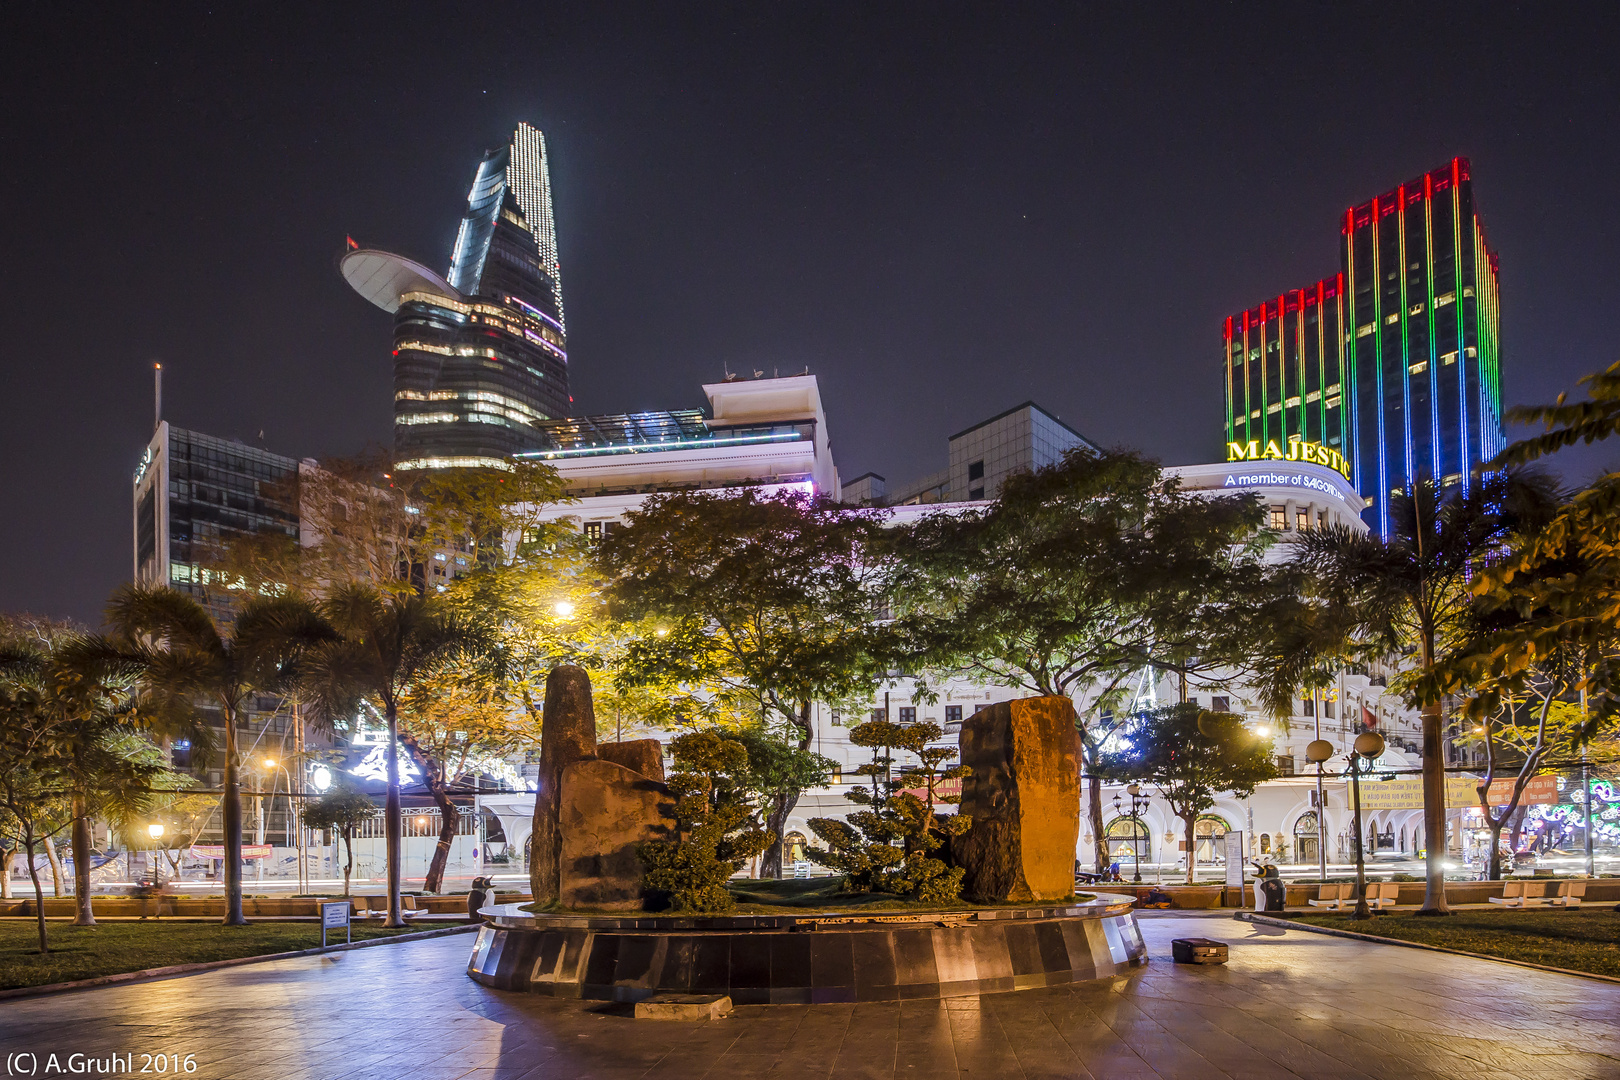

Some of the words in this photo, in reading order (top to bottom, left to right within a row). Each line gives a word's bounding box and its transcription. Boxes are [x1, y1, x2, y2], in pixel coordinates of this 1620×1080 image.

[1226, 439, 1351, 481] MAJESTIC
[1225, 474, 1236, 486] A
[1238, 472, 1289, 485] member
[1291, 474, 1303, 485] of
[1362, 758, 1387, 766] HTEL
